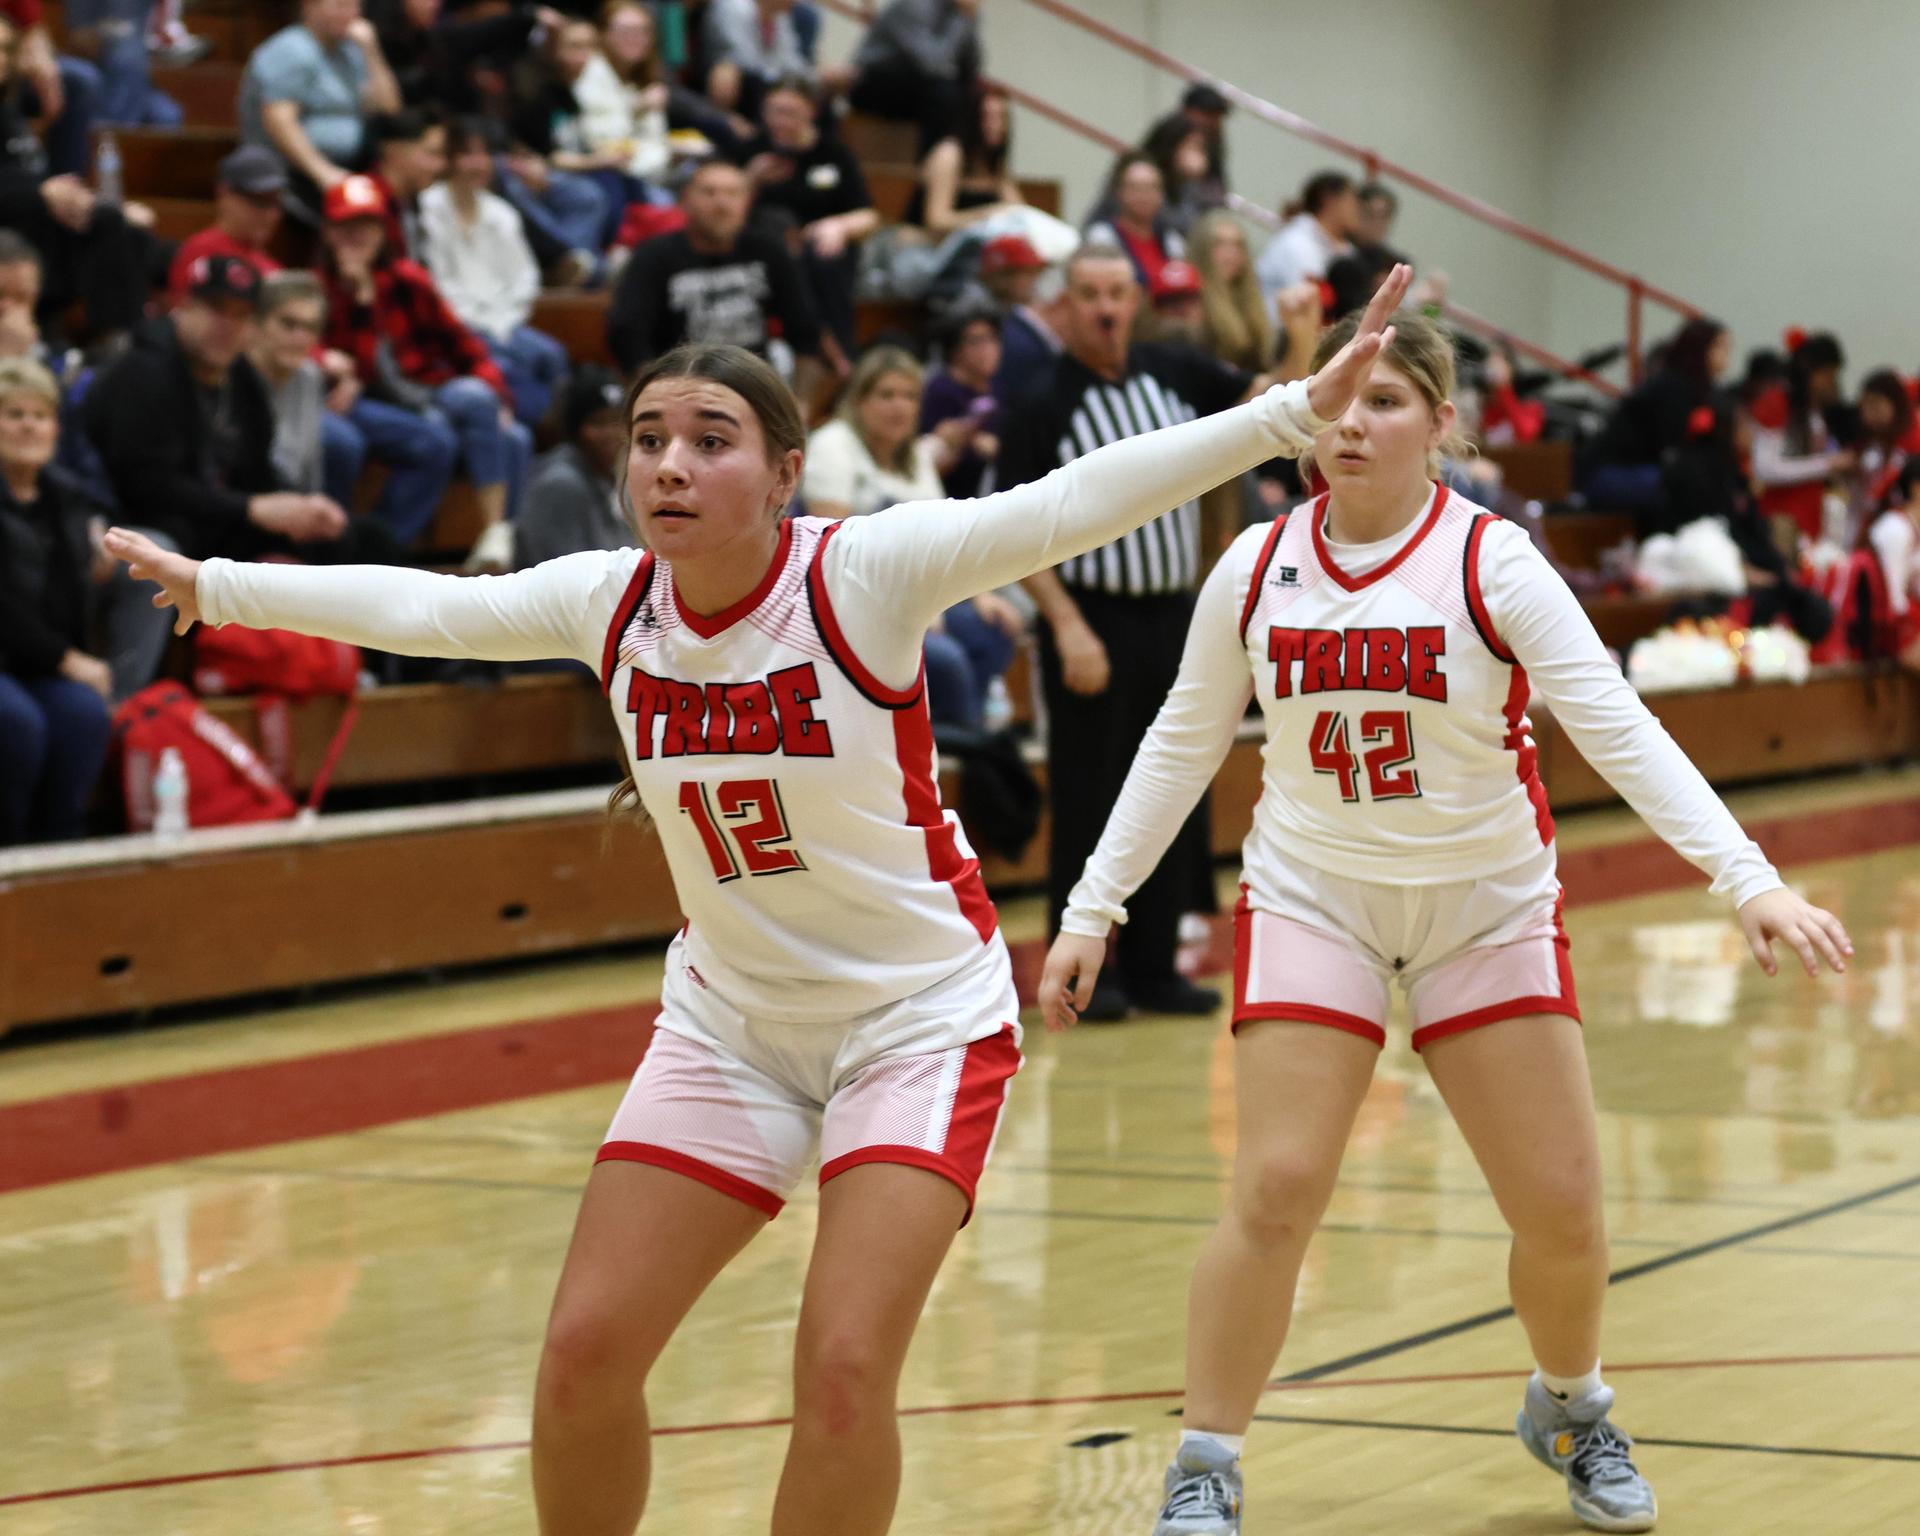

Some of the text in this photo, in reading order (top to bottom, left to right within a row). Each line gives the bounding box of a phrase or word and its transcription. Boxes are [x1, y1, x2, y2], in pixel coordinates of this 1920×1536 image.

[627, 661, 834, 761] TRIBE
[1268, 625, 1448, 704] TRIBE
[1308, 710, 1423, 803] 42
[679, 778, 809, 884] 12
